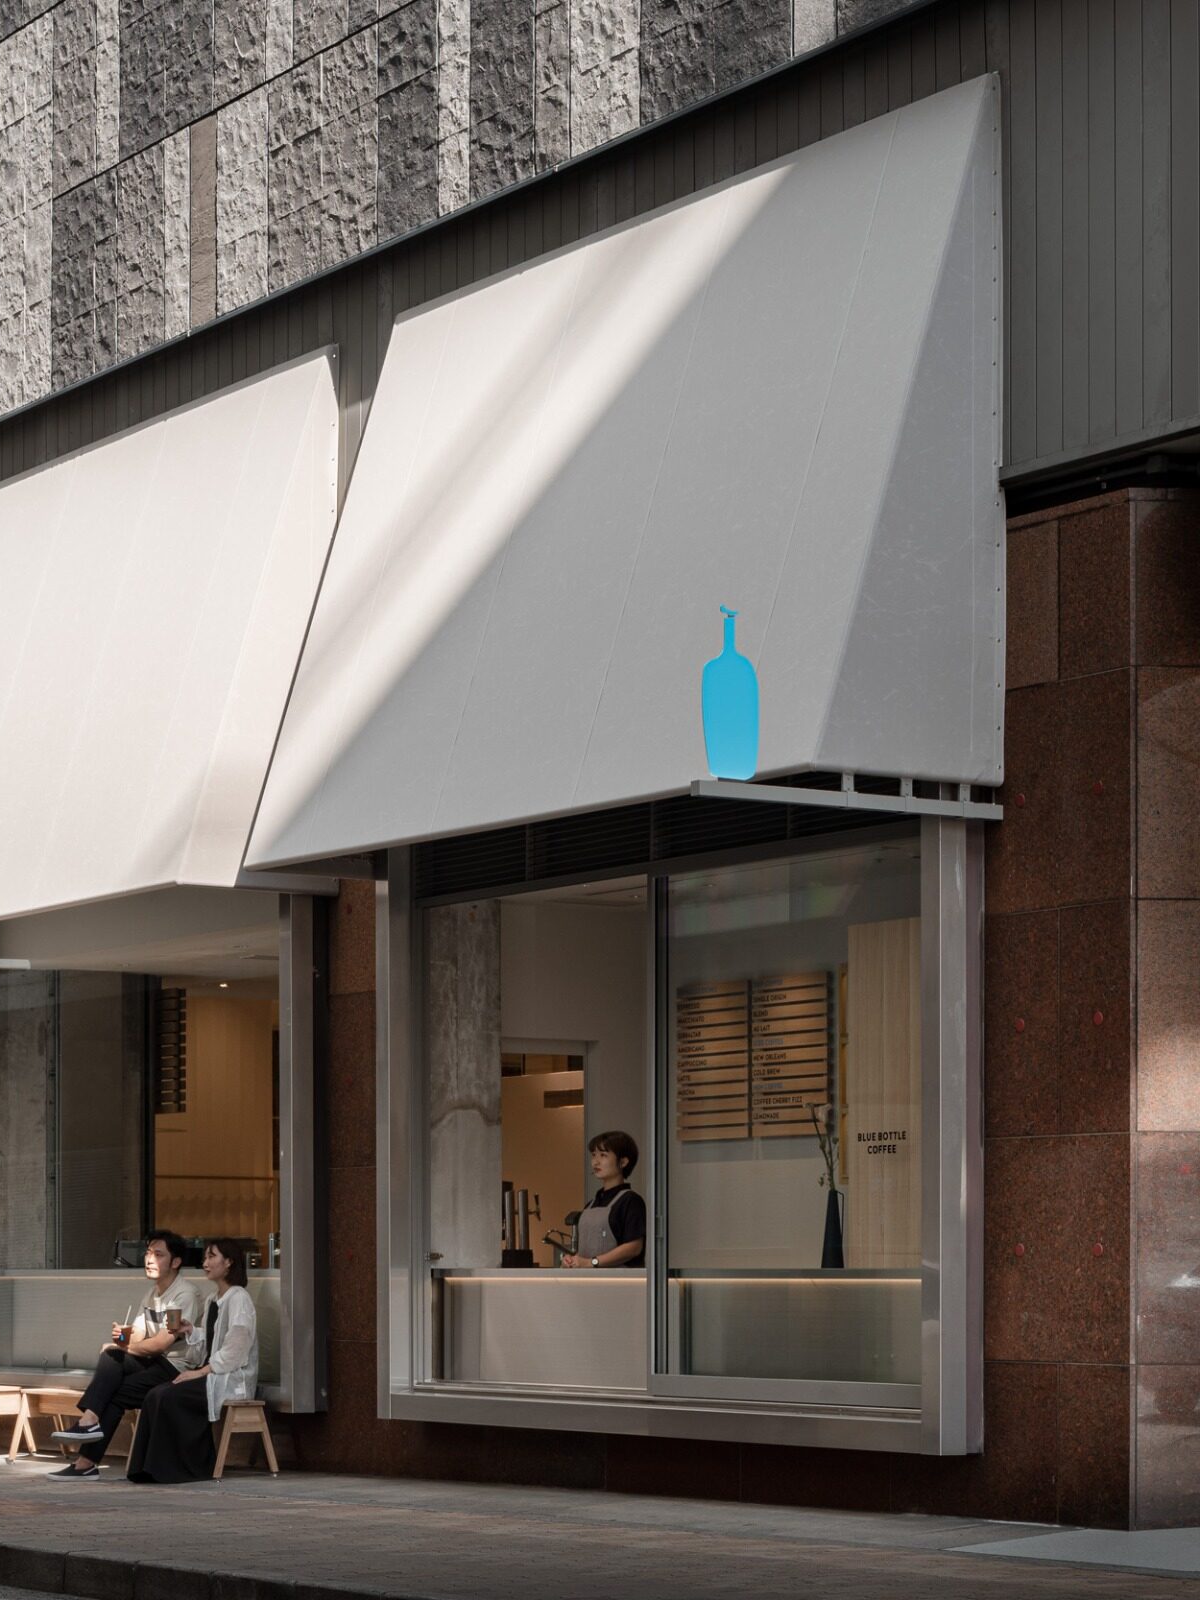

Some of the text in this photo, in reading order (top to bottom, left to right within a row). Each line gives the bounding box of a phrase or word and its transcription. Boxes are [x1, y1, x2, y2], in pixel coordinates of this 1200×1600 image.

[858, 1131, 906, 1142] BLUE BOTTLE
[867, 1145, 896, 1154] COFFEE
